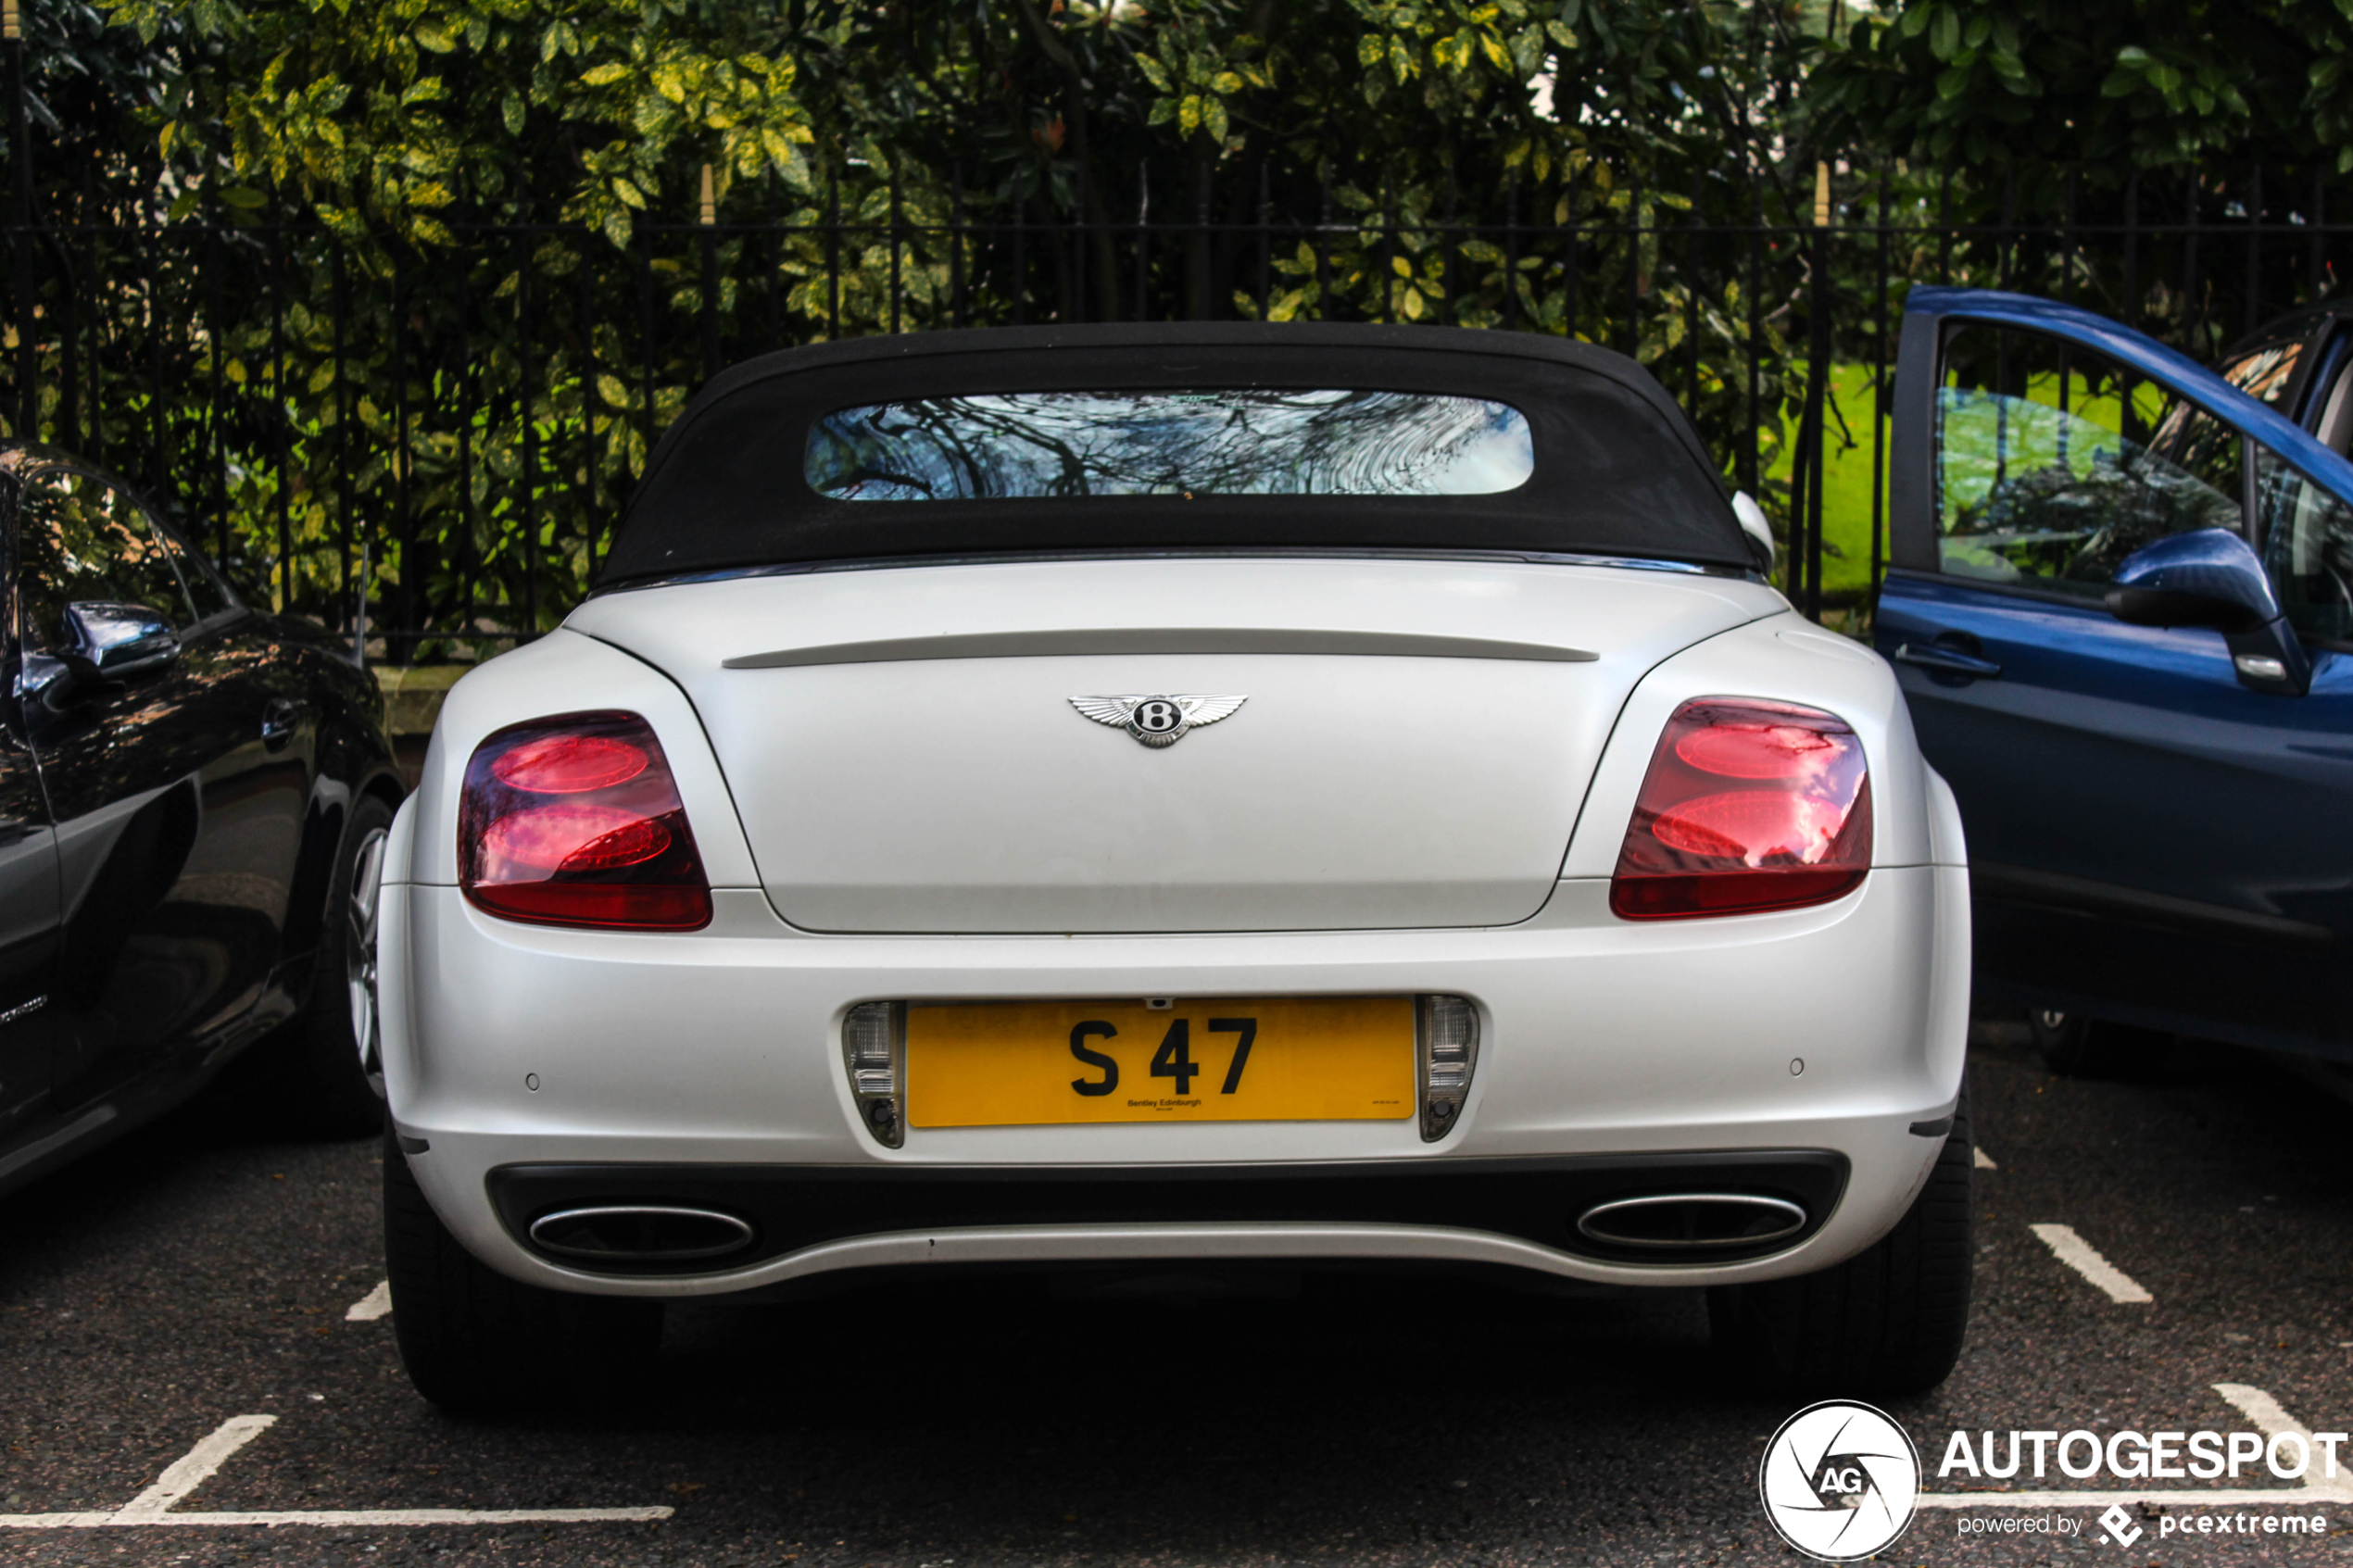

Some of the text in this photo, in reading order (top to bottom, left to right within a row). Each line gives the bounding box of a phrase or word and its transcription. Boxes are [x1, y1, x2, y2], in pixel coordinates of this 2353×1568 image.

[1070, 1018, 1257, 1097] S 47
[1127, 1098, 1202, 1108] Bentley Edinburgh
